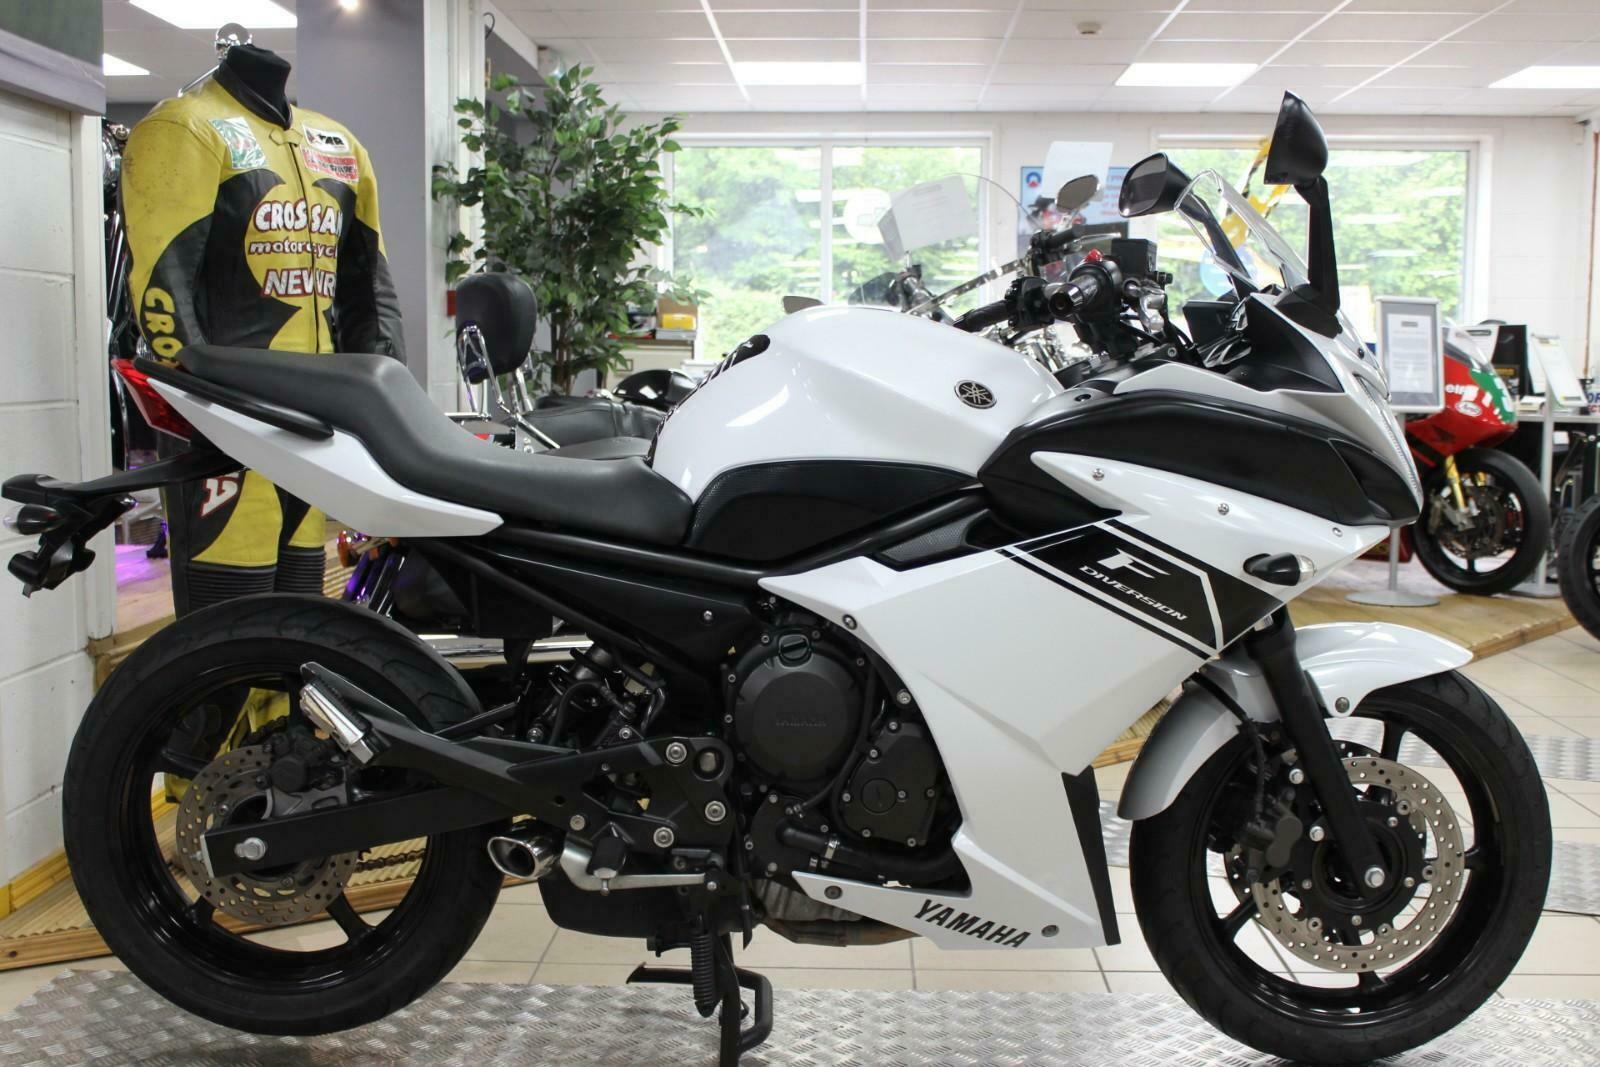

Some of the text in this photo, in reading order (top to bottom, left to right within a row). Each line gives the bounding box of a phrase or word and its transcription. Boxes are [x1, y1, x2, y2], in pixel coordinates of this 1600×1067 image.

[144, 287, 184, 368] CRO
[1079, 565, 1188, 620] DIVERSION
[914, 899, 1031, 948] YAMAHA
